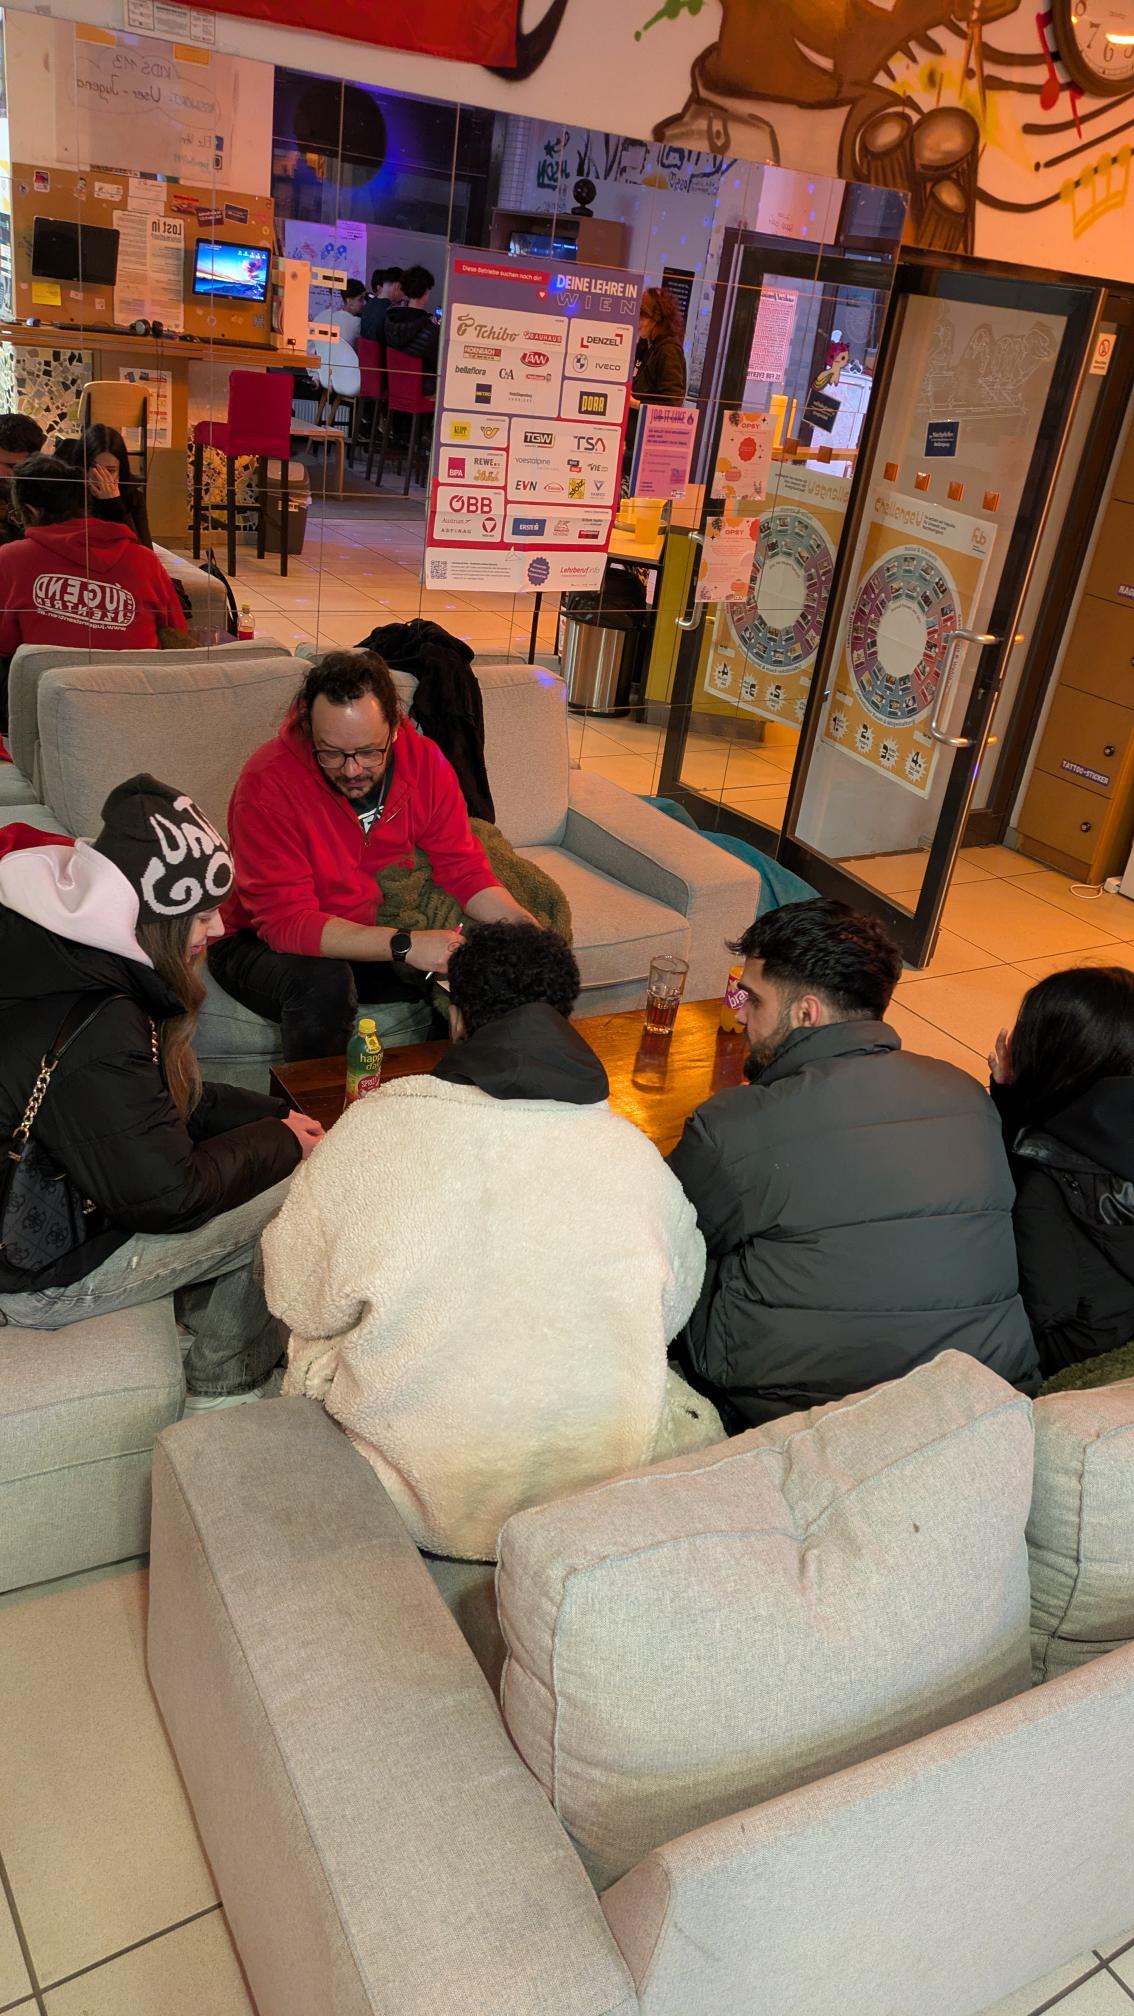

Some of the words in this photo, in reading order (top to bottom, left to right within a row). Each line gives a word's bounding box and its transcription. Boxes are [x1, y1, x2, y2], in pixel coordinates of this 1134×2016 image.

[1087, 20, 1101, 48] 7
[478, 267, 499, 275] Betriebe
[557, 274, 589, 292] DEINE
[591, 277, 625, 297] LEHRE
[626, 284, 638, 298] IN
[557, 292, 636, 316] WIEN
[474, 324, 520, 342] Tchibo
[530, 333, 562, 343] BAUHAUS
[587, 336, 619, 347] DENZEL
[455, 365, 487, 376] bellaflora
[499, 368, 514, 380] C&A
[525, 433, 552, 443] TGW
[474, 458, 494, 466] REWE
[515, 456, 551, 465] voestalpine
[450, 469, 463, 477] BIPA
[515, 480, 537, 491] EVN
[449, 494, 493, 514] ÖBB
[1062, 760, 1109, 785] TATTOO-STICKER
